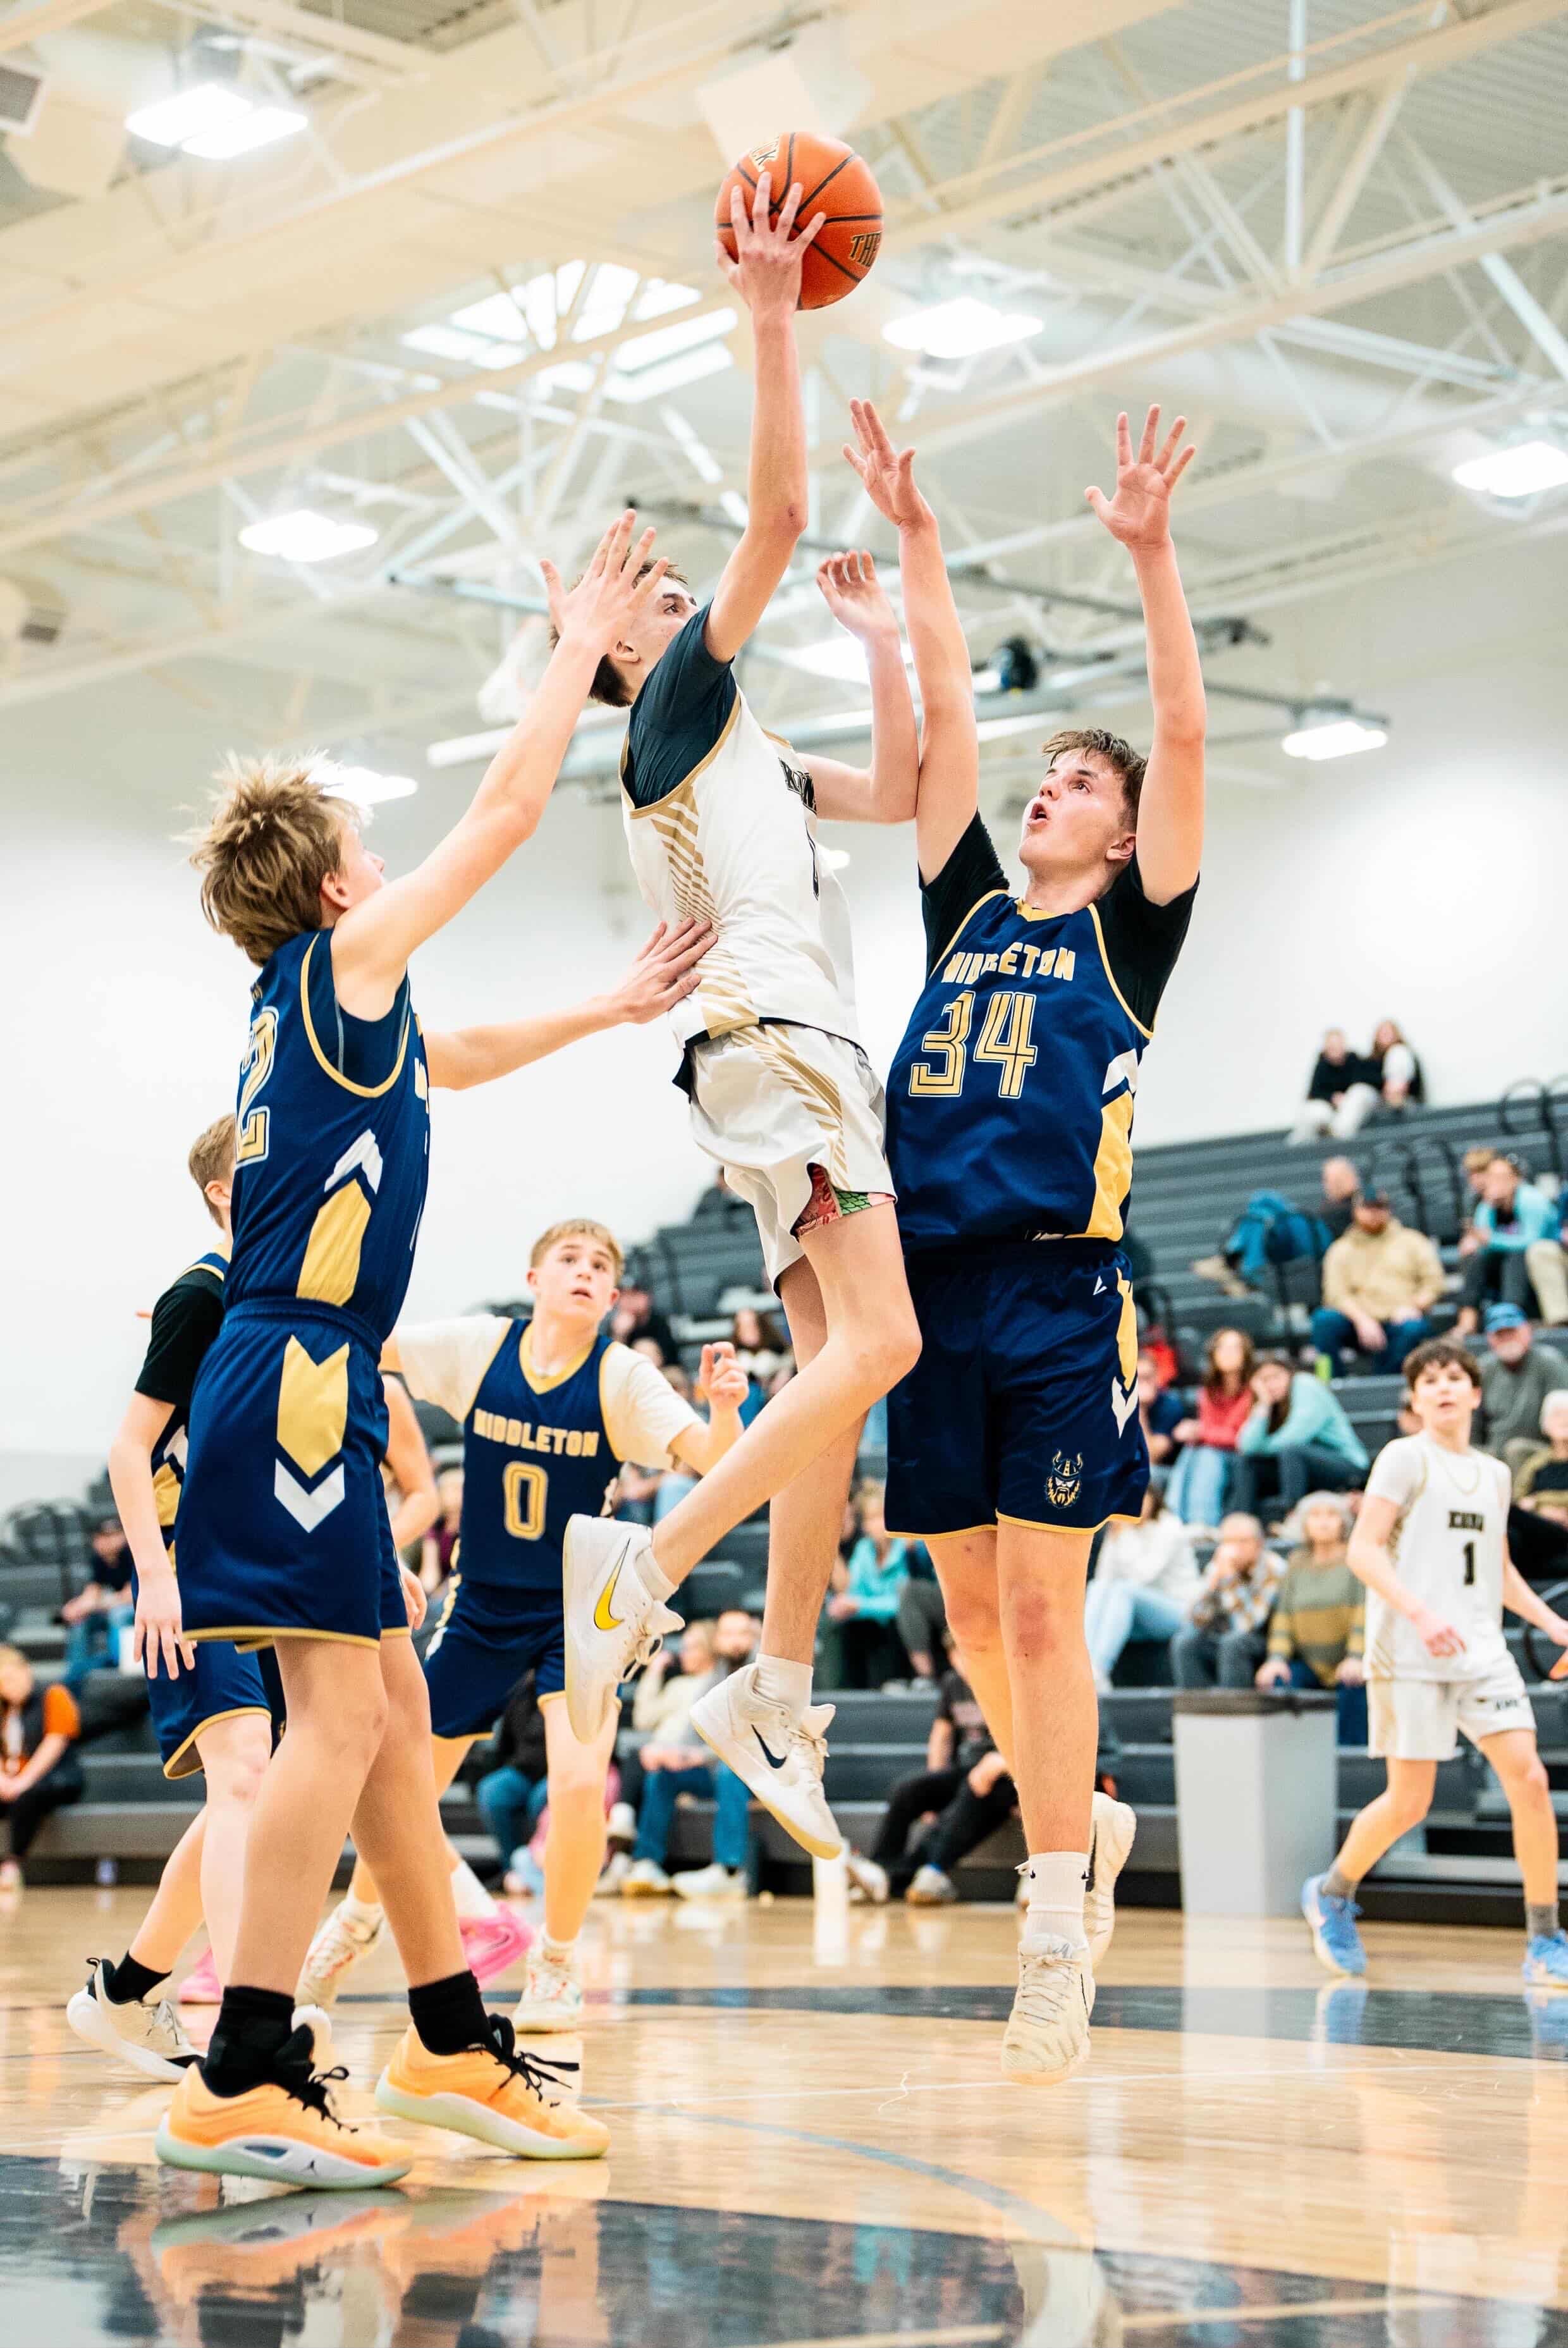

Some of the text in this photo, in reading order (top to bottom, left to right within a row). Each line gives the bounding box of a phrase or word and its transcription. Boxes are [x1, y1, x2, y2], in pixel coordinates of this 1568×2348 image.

[941, 942, 1075, 985] MIDETON
[909, 990, 1038, 1098] 34
[474, 1408, 599, 1456] MIDDLETON
[503, 1461, 548, 1541] 0
[1463, 1541, 1475, 1585] 1
